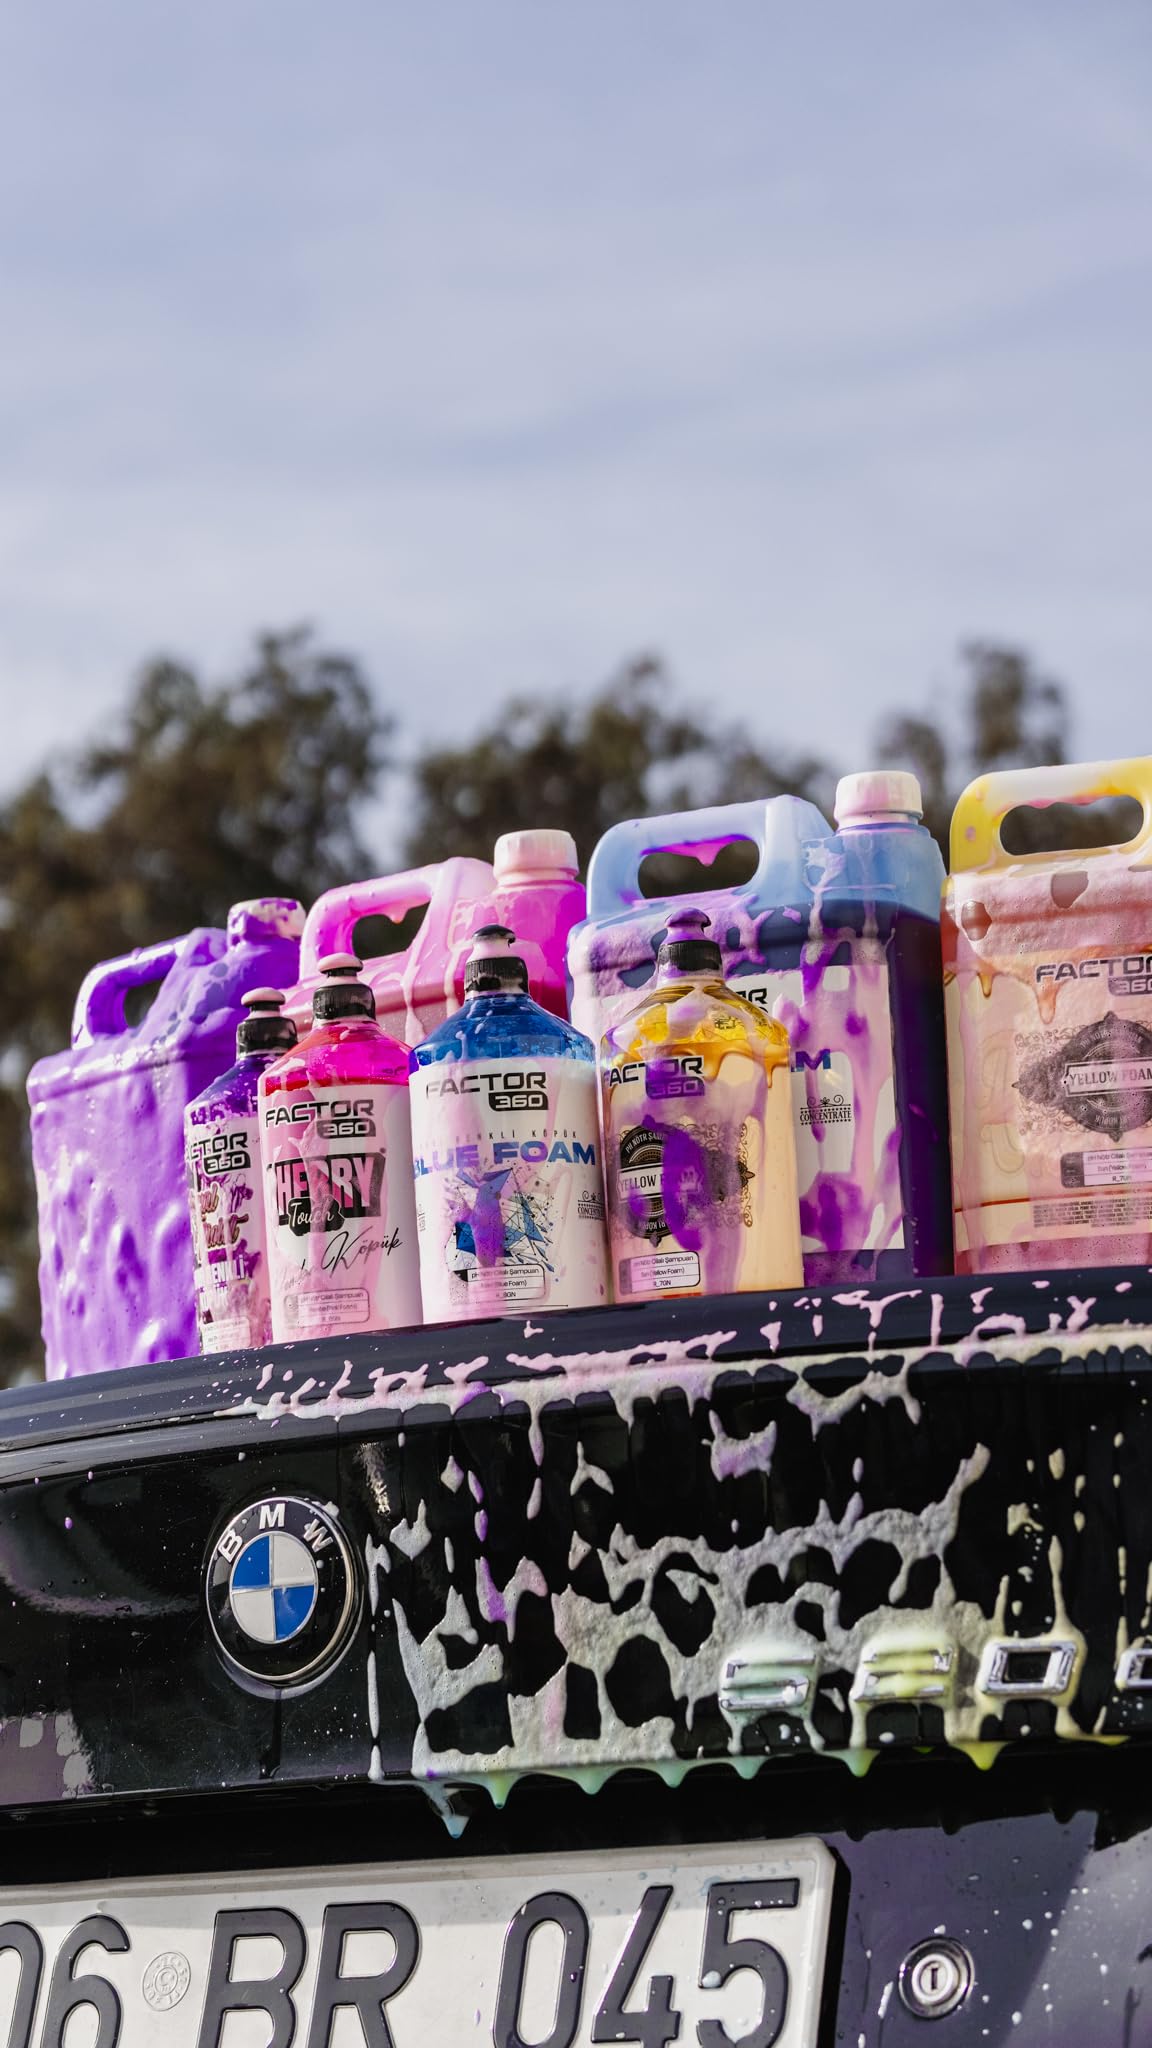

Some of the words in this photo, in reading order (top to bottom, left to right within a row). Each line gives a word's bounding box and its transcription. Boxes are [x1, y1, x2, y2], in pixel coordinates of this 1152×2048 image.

[426, 1071, 547, 1099] FACTOR
[266, 1099, 375, 1128] FACTOR
[495, 1094, 544, 1109] 360
[322, 1121, 371, 1136] 360
[799, 1110, 852, 1122] CONCENTRATE
[190, 1132, 248, 1160] CTOR
[493, 1140, 596, 1166] FOAM
[206, 1153, 246, 1173] 360
[273, 1156, 375, 1217] HERRY
[619, 1174, 657, 1194] YELLOW
[217, 1502, 334, 1563] BMW
[195, 1900, 421, 2048] BR
[492, 1877, 800, 2048] 045
